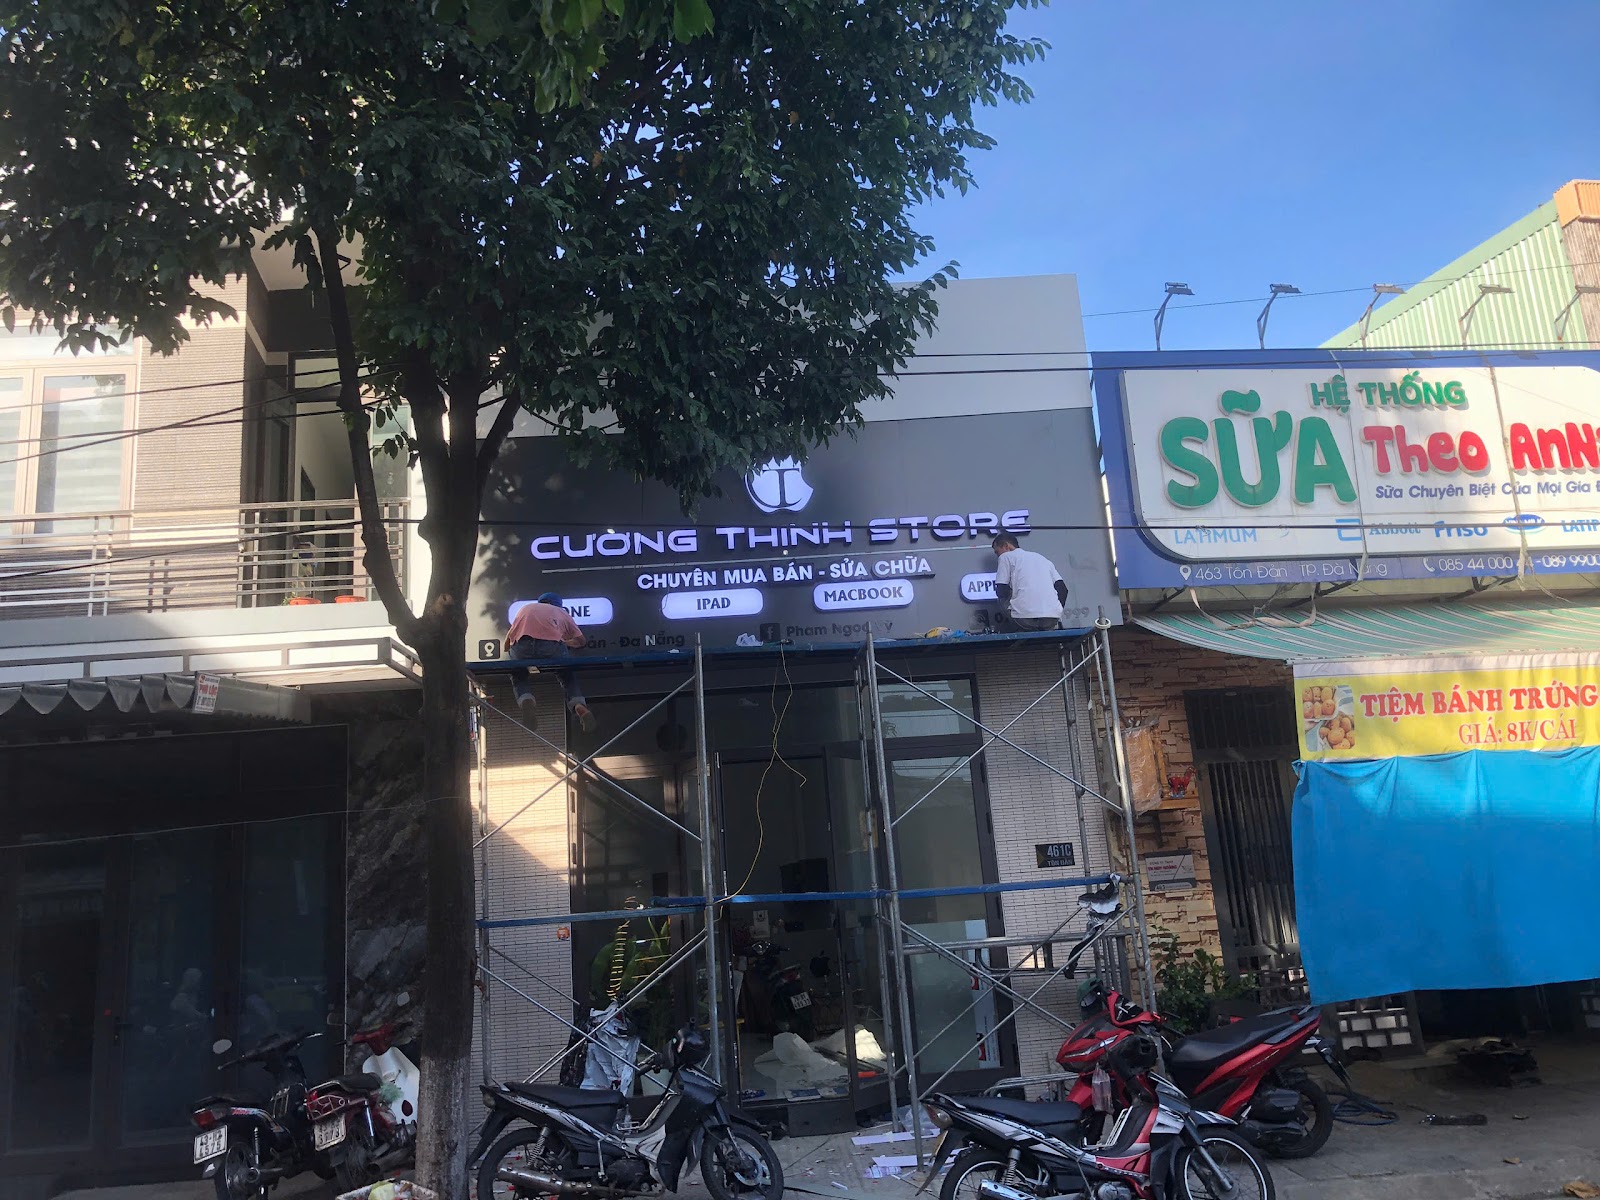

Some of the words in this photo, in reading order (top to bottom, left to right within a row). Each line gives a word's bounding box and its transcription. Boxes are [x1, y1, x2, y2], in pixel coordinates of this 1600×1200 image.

[1310, 374, 1351, 414] HỆ
[1359, 370, 1466, 409] THỐNG
[1159, 389, 1358, 508] SỮA
[1362, 425, 1488, 475] Theo
[1509, 422, 1600, 471] AnN
[1375, 484, 1404, 499] Sữa
[1408, 484, 1464, 500] Chuyên
[1469, 483, 1496, 498] Biệt
[1537, 481, 1562, 497] Mọi
[1566, 480, 1591, 493] Gia
[530, 528, 698, 560] CƯỜNG
[715, 520, 852, 556] THỊNH
[869, 509, 1031, 541] STORE
[637, 567, 717, 590] CHUYÊN
[723, 567, 767, 586] MUA
[773, 561, 813, 582] BÁN
[829, 556, 868, 579] SỬA
[874, 554, 932, 576] CHỮA
[1195, 566, 1222, 580] 463
[1225, 566, 1253, 580] Tôn
[1257, 564, 1288, 578] Đản
[1323, 562, 1345, 576] Đà
[1438, 558, 1464, 571] 085
[1467, 557, 1485, 570] 44
[1487, 556, 1513, 569] 000
[696, 597, 731, 611] IPAD
[823, 585, 904, 603] MACBOOK
[1360, 687, 1425, 722] TIỆM
[1431, 684, 1503, 714] BÁNH
[1509, 680, 1598, 711] TRỨNG
[1459, 716, 1502, 745] GIÁ:
[1507, 713, 1576, 742] 8K/CÁI
[1047, 844, 1071, 857] 461C
